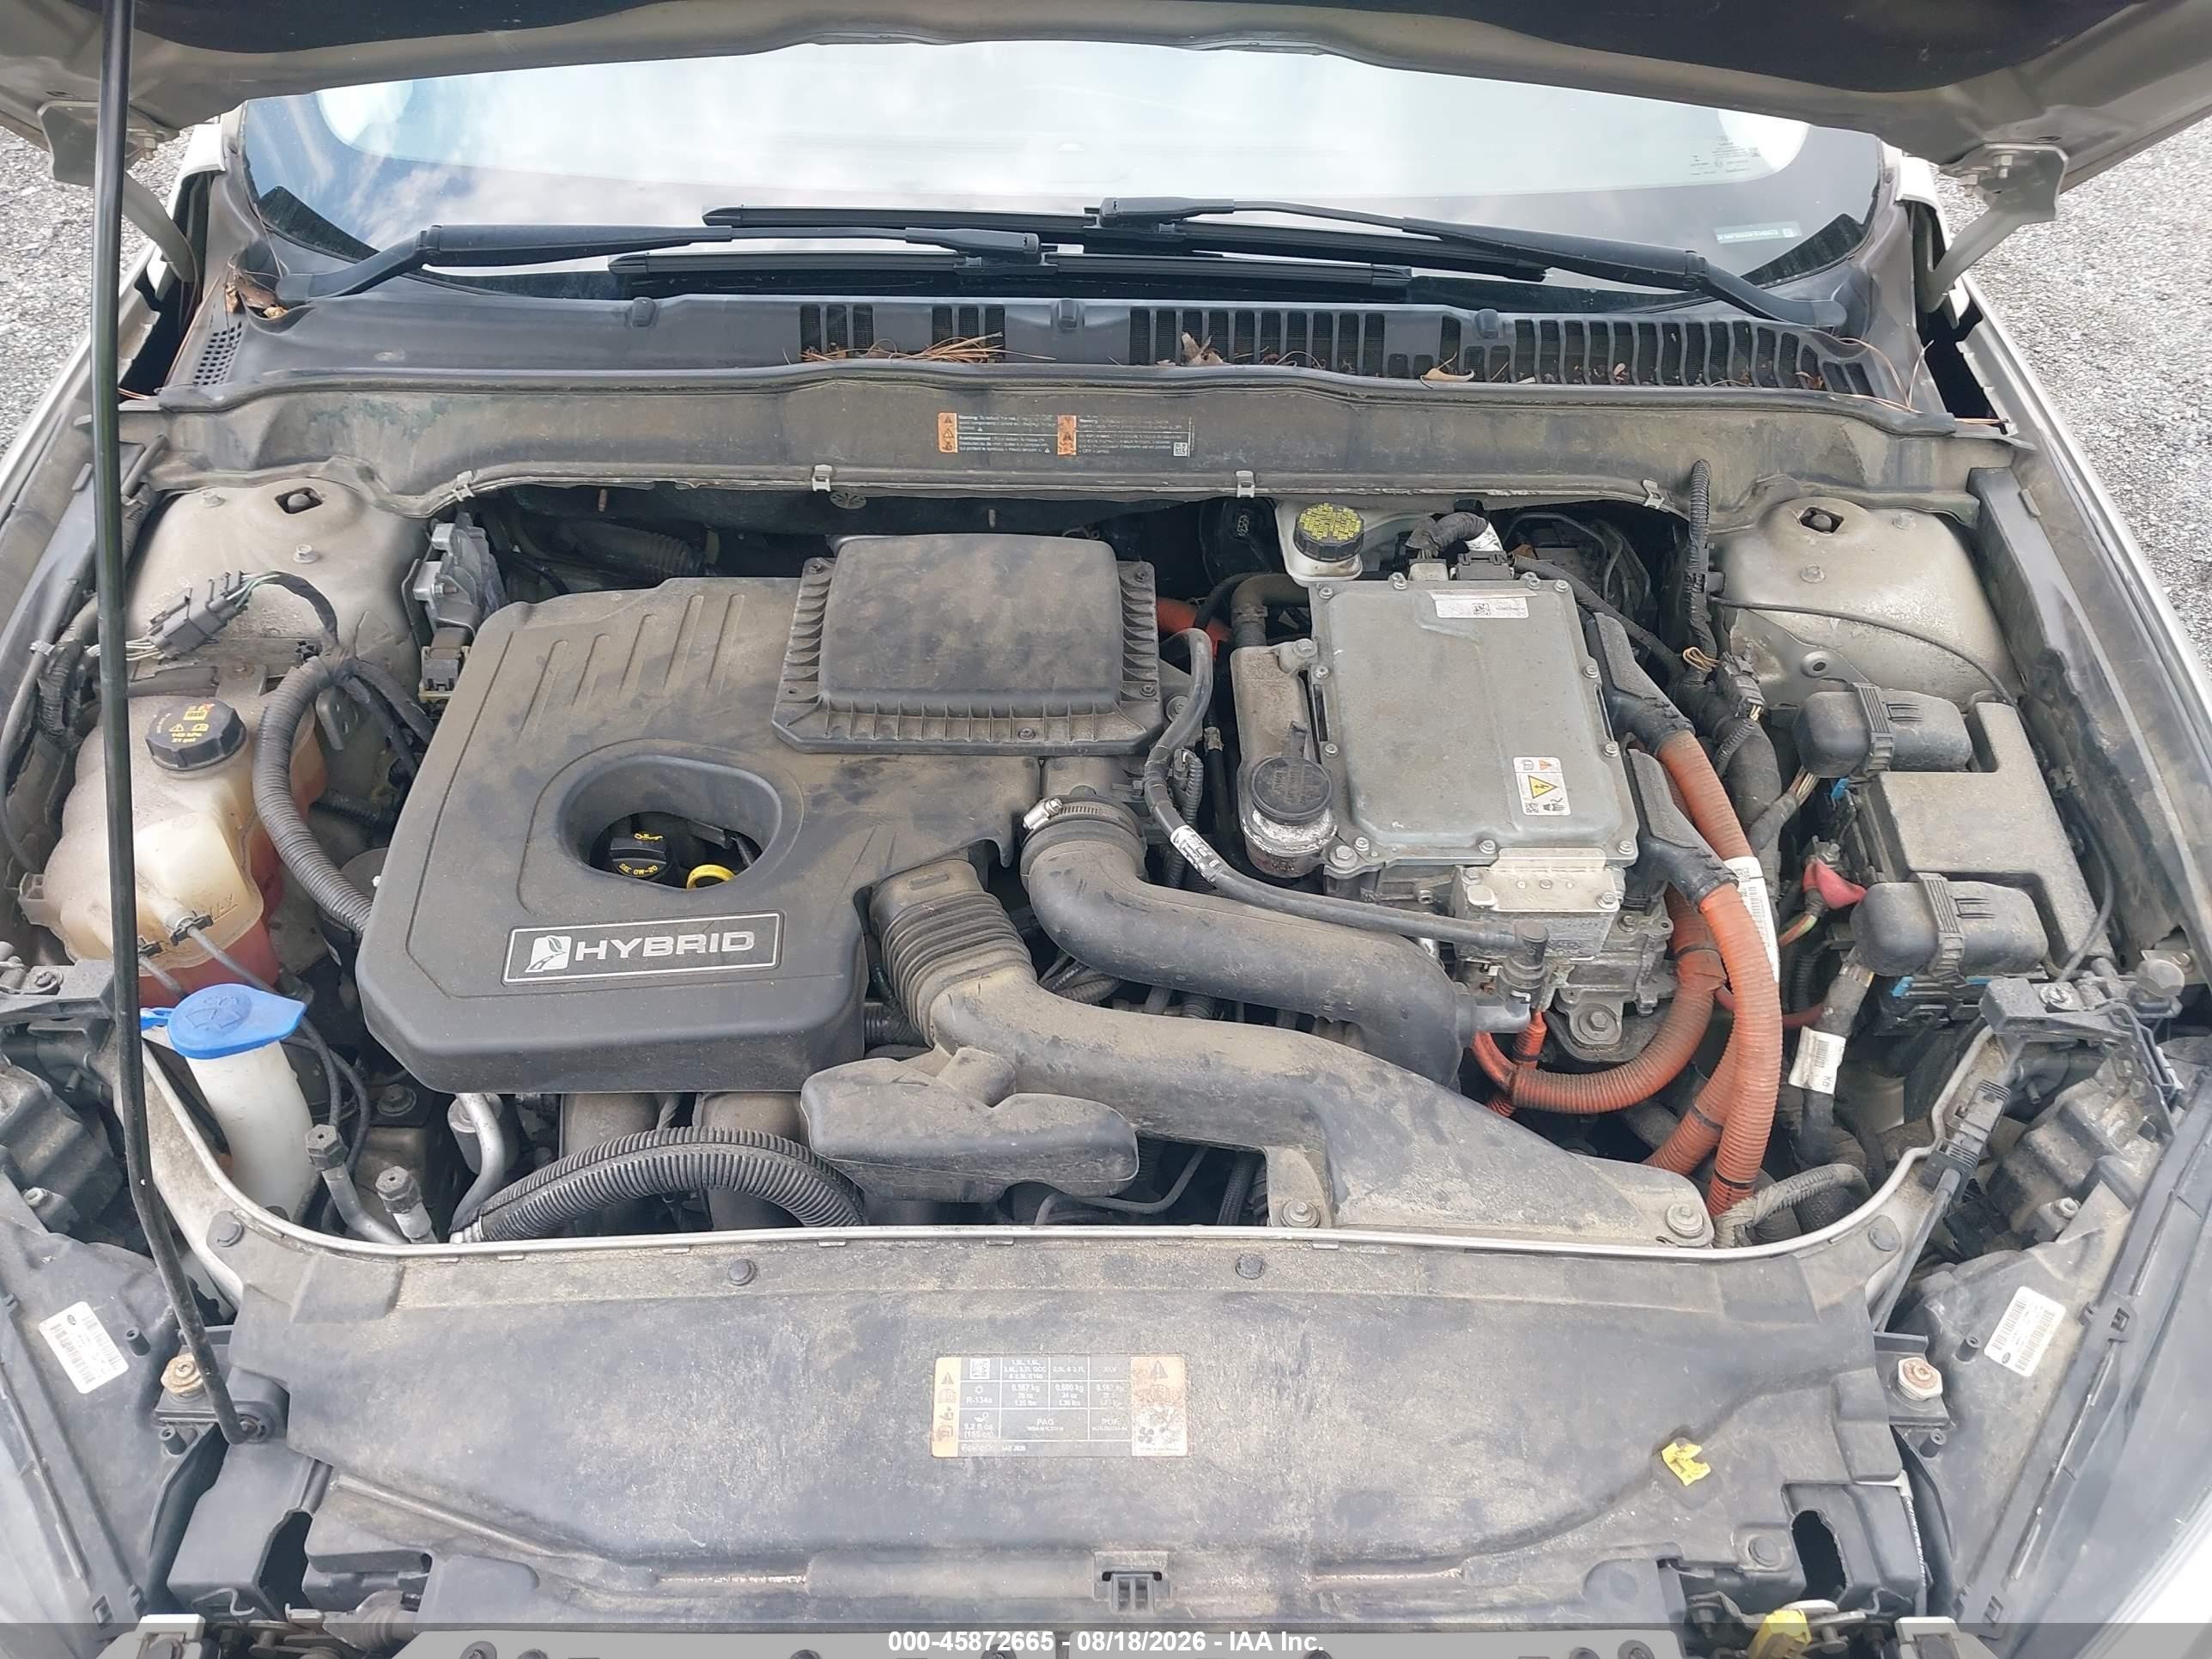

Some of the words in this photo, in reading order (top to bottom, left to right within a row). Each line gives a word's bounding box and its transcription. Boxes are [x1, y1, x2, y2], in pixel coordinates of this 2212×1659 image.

[618, 862, 633, 874] SAE
[633, 864, 659, 876] 0W-20
[574, 931, 756, 962] HYBRID
